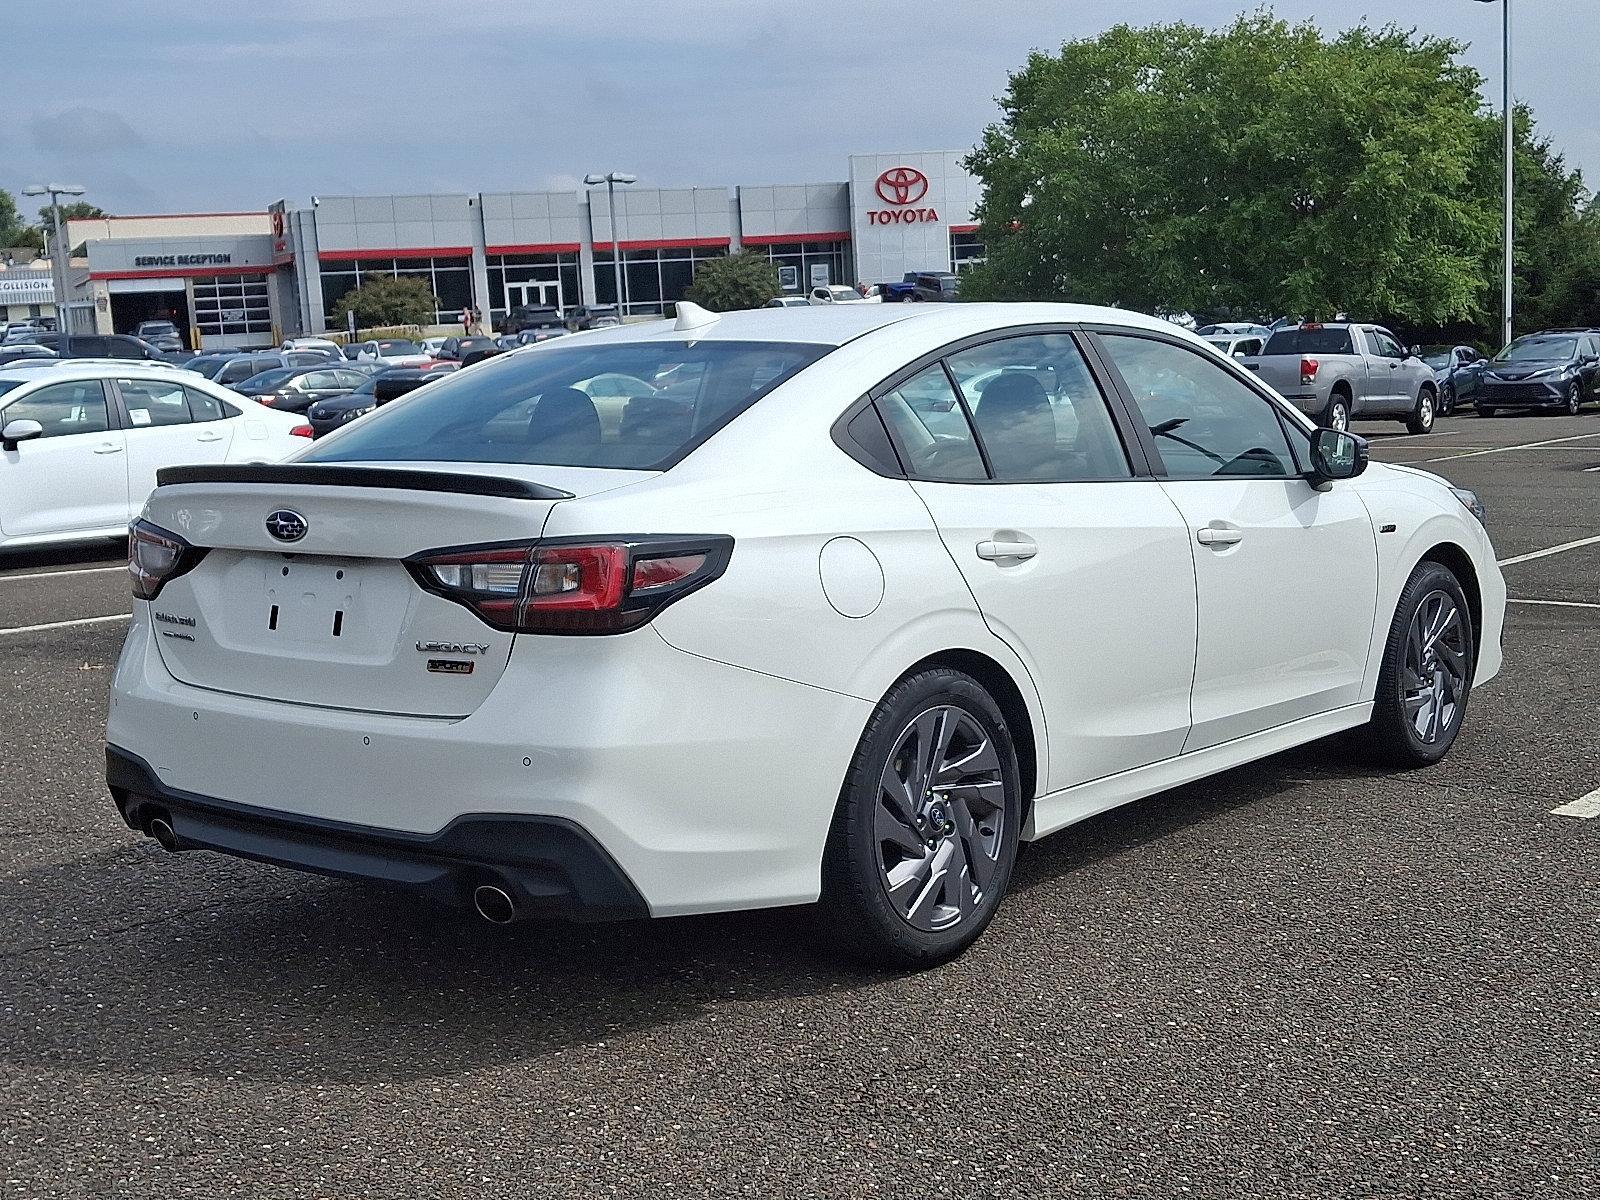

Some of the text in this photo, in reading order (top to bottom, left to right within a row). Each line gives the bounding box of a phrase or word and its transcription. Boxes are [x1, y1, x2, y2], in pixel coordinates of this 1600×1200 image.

[867, 208, 939, 225] TOYOTA
[134, 253, 231, 267] SERVICE RECEPTION
[0, 281, 48, 290] OLLISION
[415, 640, 490, 655] LEGACY
